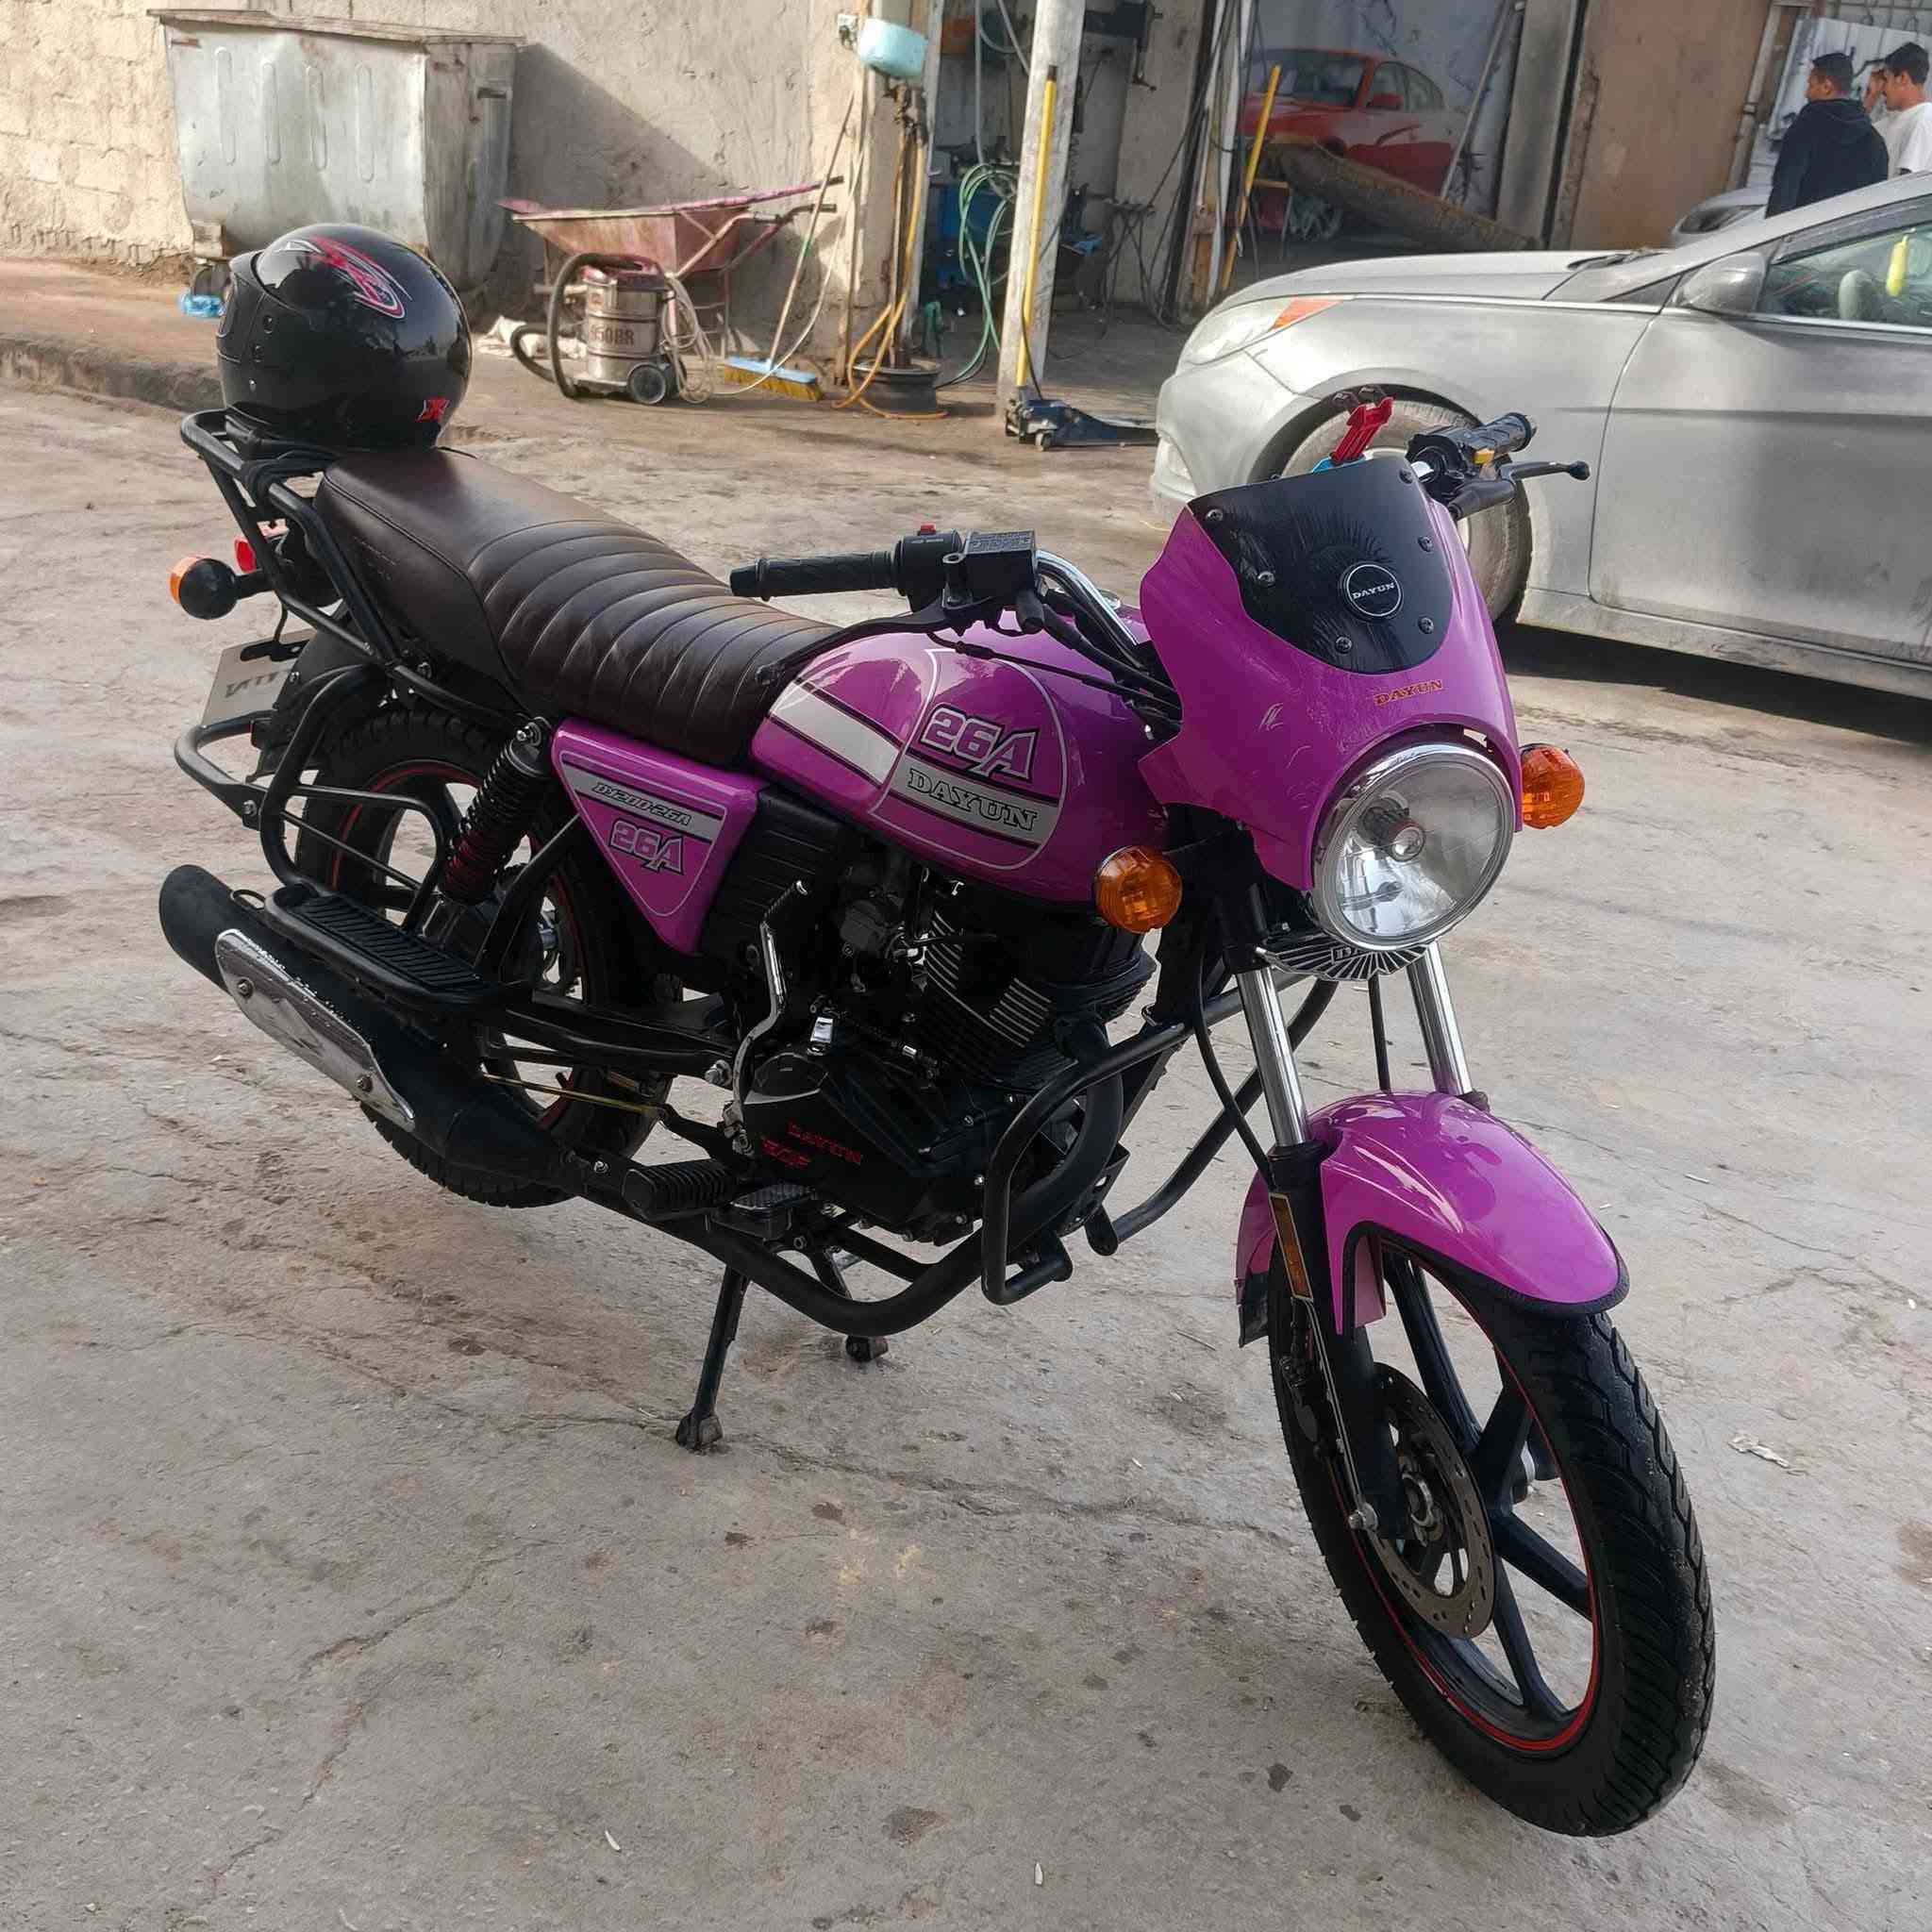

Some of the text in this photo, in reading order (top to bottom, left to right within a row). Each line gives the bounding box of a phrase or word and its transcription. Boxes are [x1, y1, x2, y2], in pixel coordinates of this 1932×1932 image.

[1352, 581, 1395, 600] DAYUN
[1374, 679, 1443, 706] DAYUN
[922, 704, 1039, 782] 26A
[908, 768, 1038, 831] DAYUN
[610, 817, 684, 875] 26A
